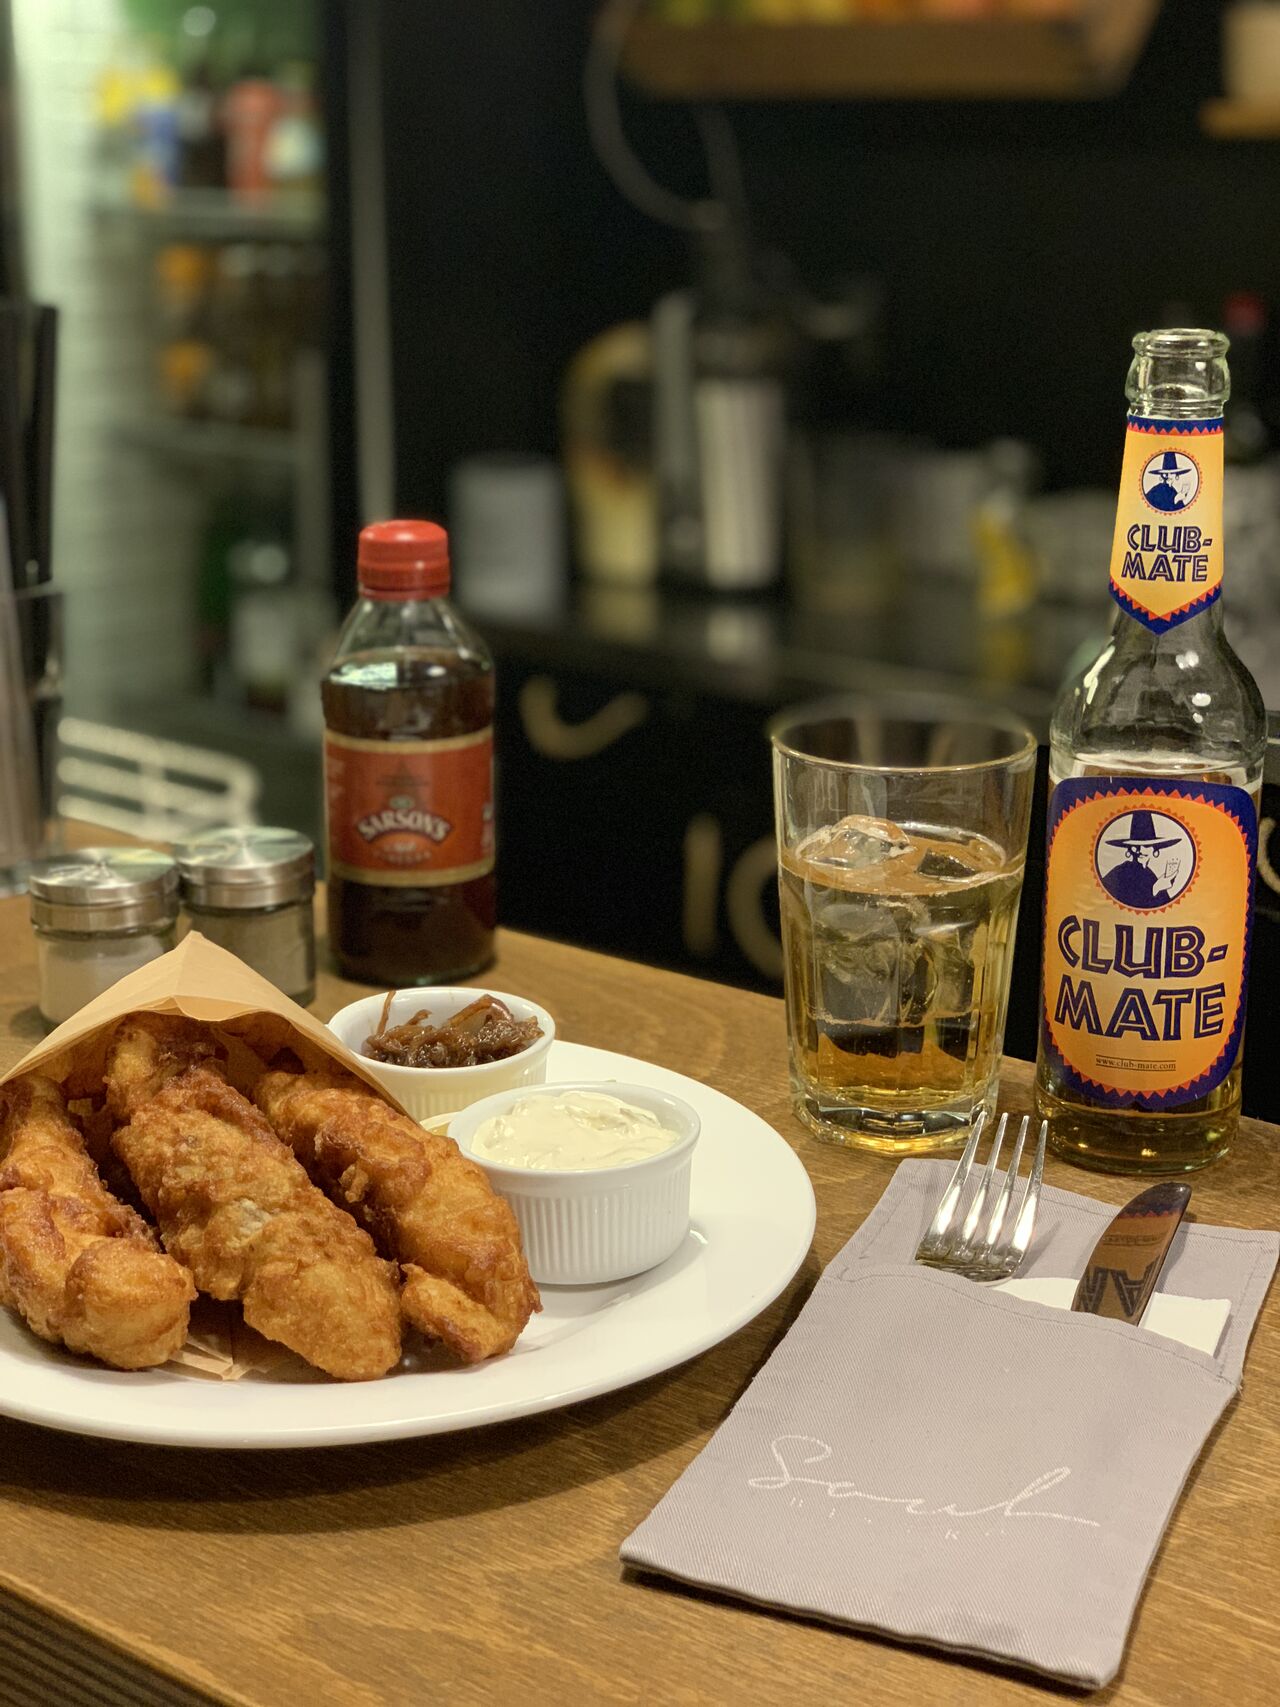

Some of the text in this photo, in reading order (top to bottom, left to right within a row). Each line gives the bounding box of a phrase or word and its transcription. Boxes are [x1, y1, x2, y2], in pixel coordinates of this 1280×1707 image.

[1127, 523, 1213, 553] CLUB-
[1121, 551, 1209, 582] MATE
[1057, 915, 1229, 979] CLUB-
[1054, 973, 1226, 1041] MATE
[1095, 1057, 1176, 1071] www.club-mate.com
